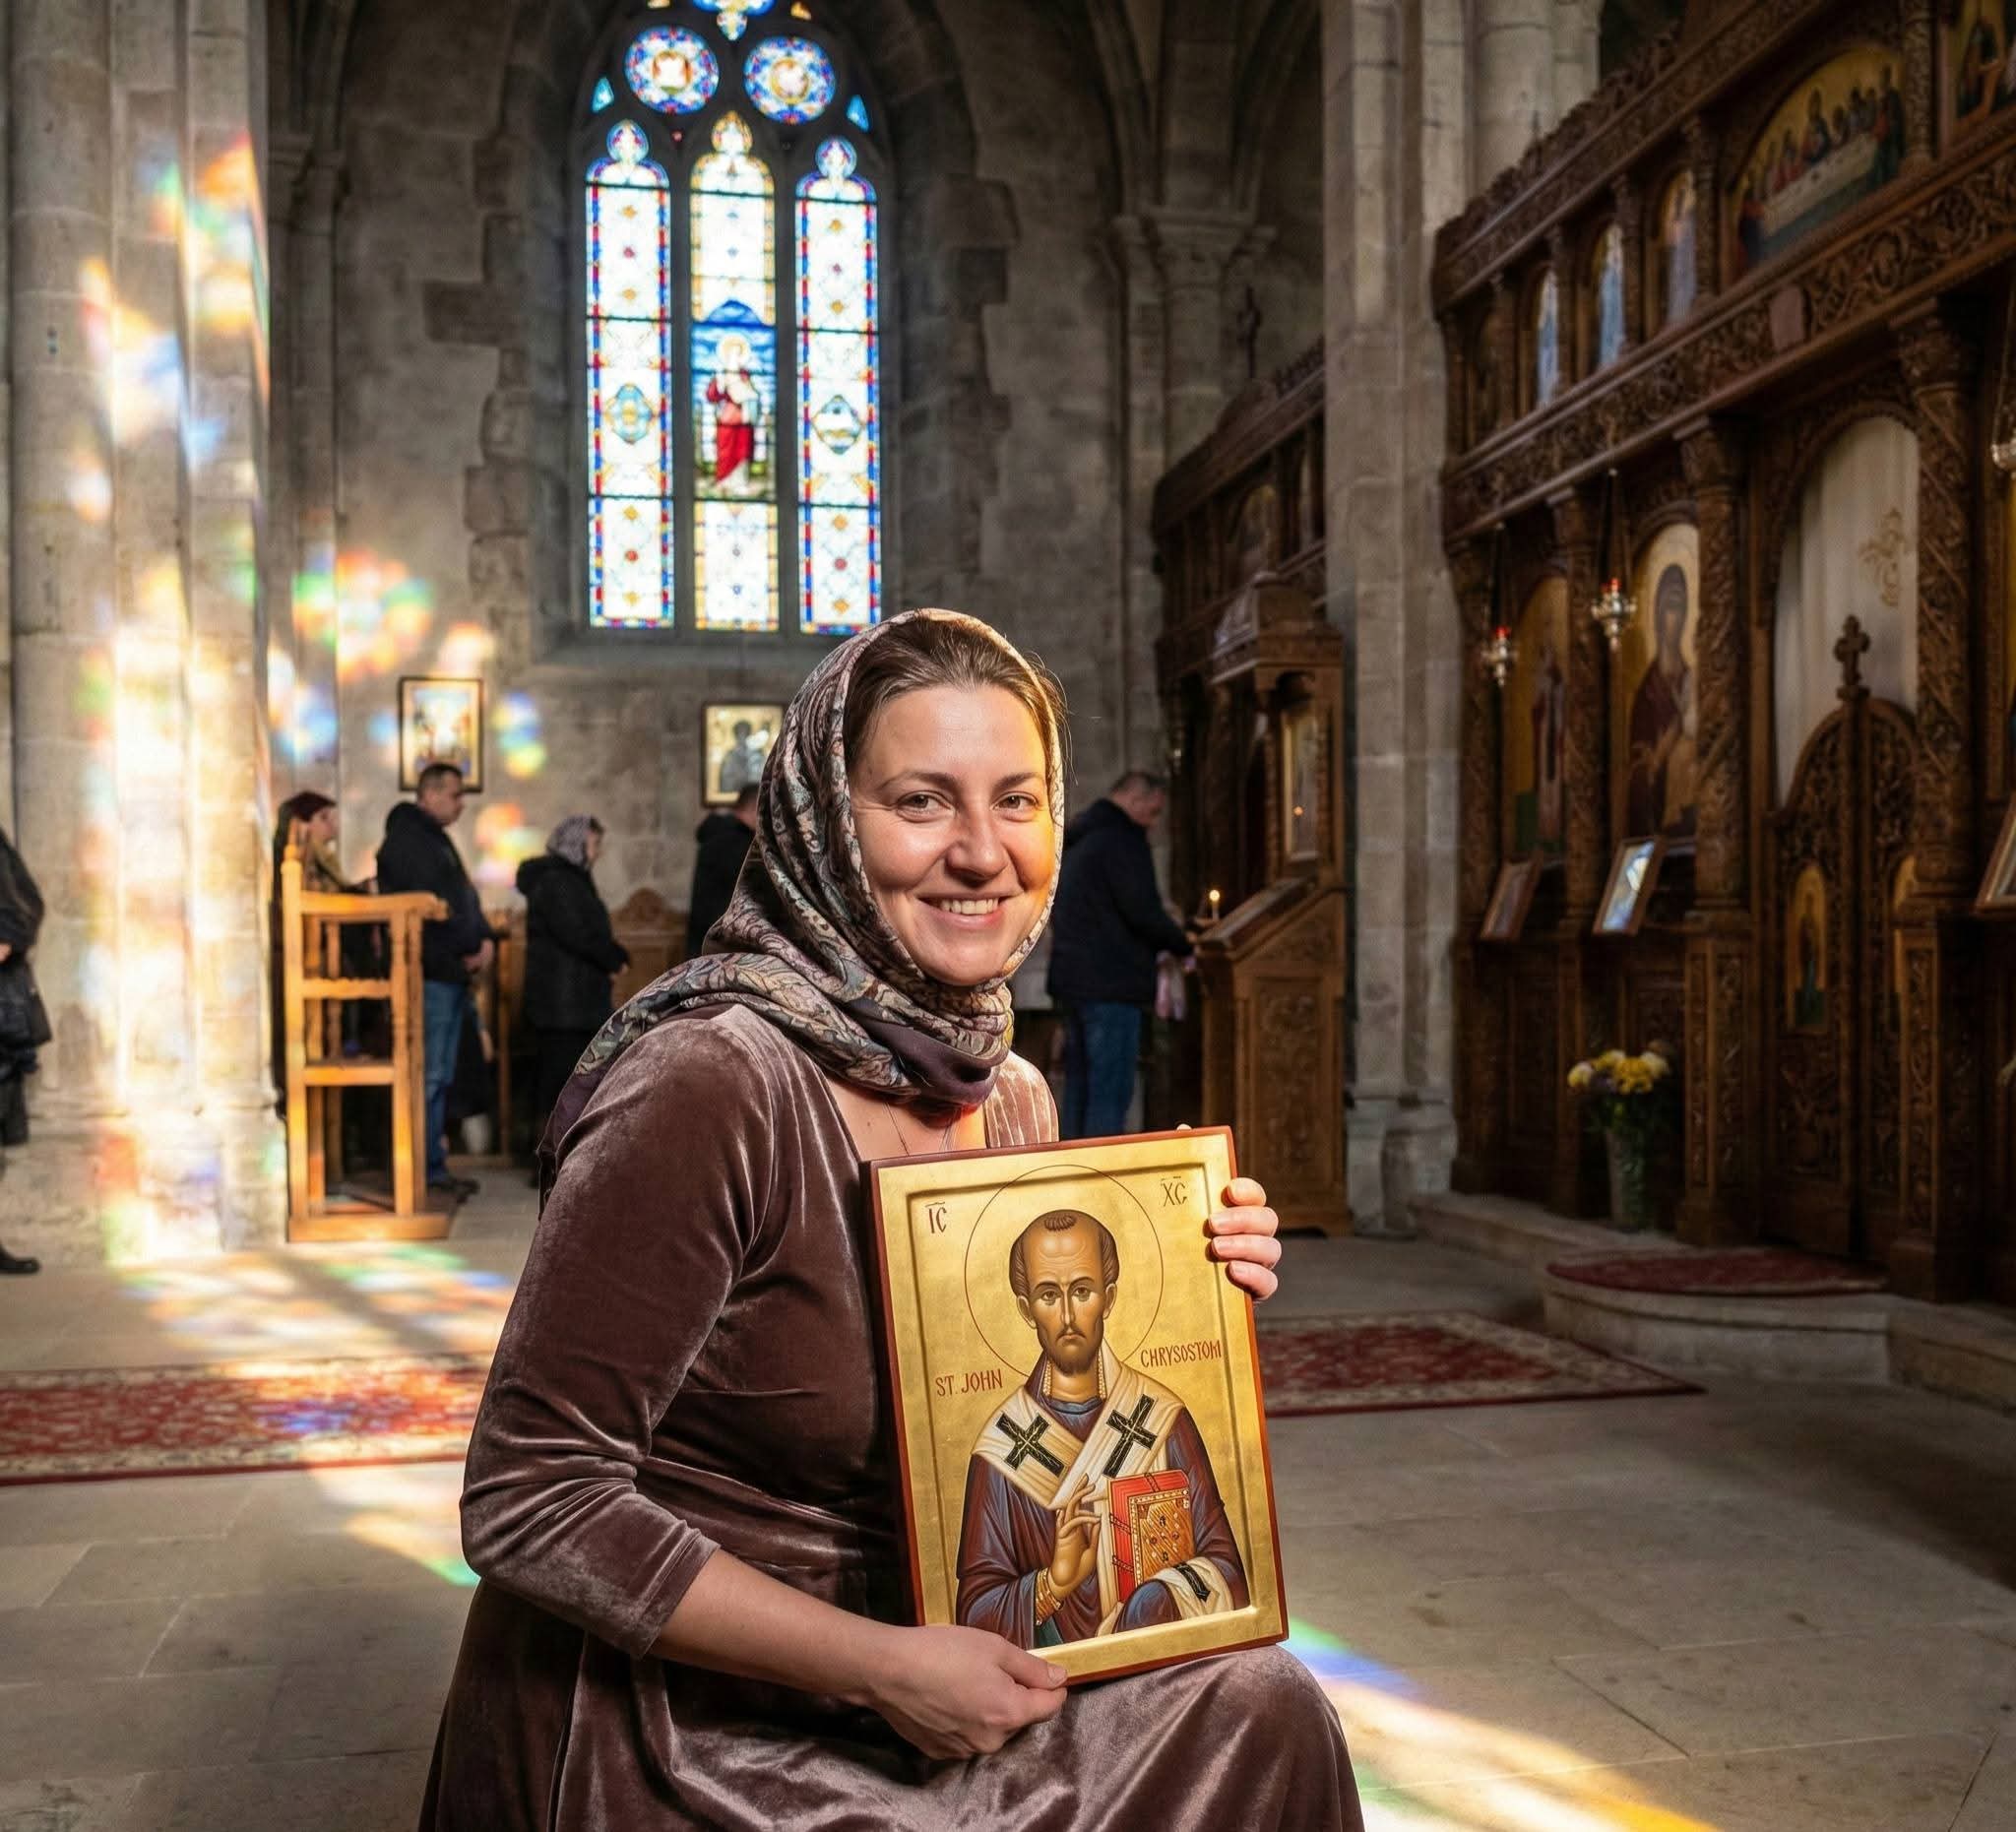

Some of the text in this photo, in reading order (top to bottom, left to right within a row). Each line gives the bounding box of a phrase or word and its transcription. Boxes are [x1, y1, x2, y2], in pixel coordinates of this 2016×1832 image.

[935, 1340, 1222, 1397] ST. JOHN CHRYSOSTOM
